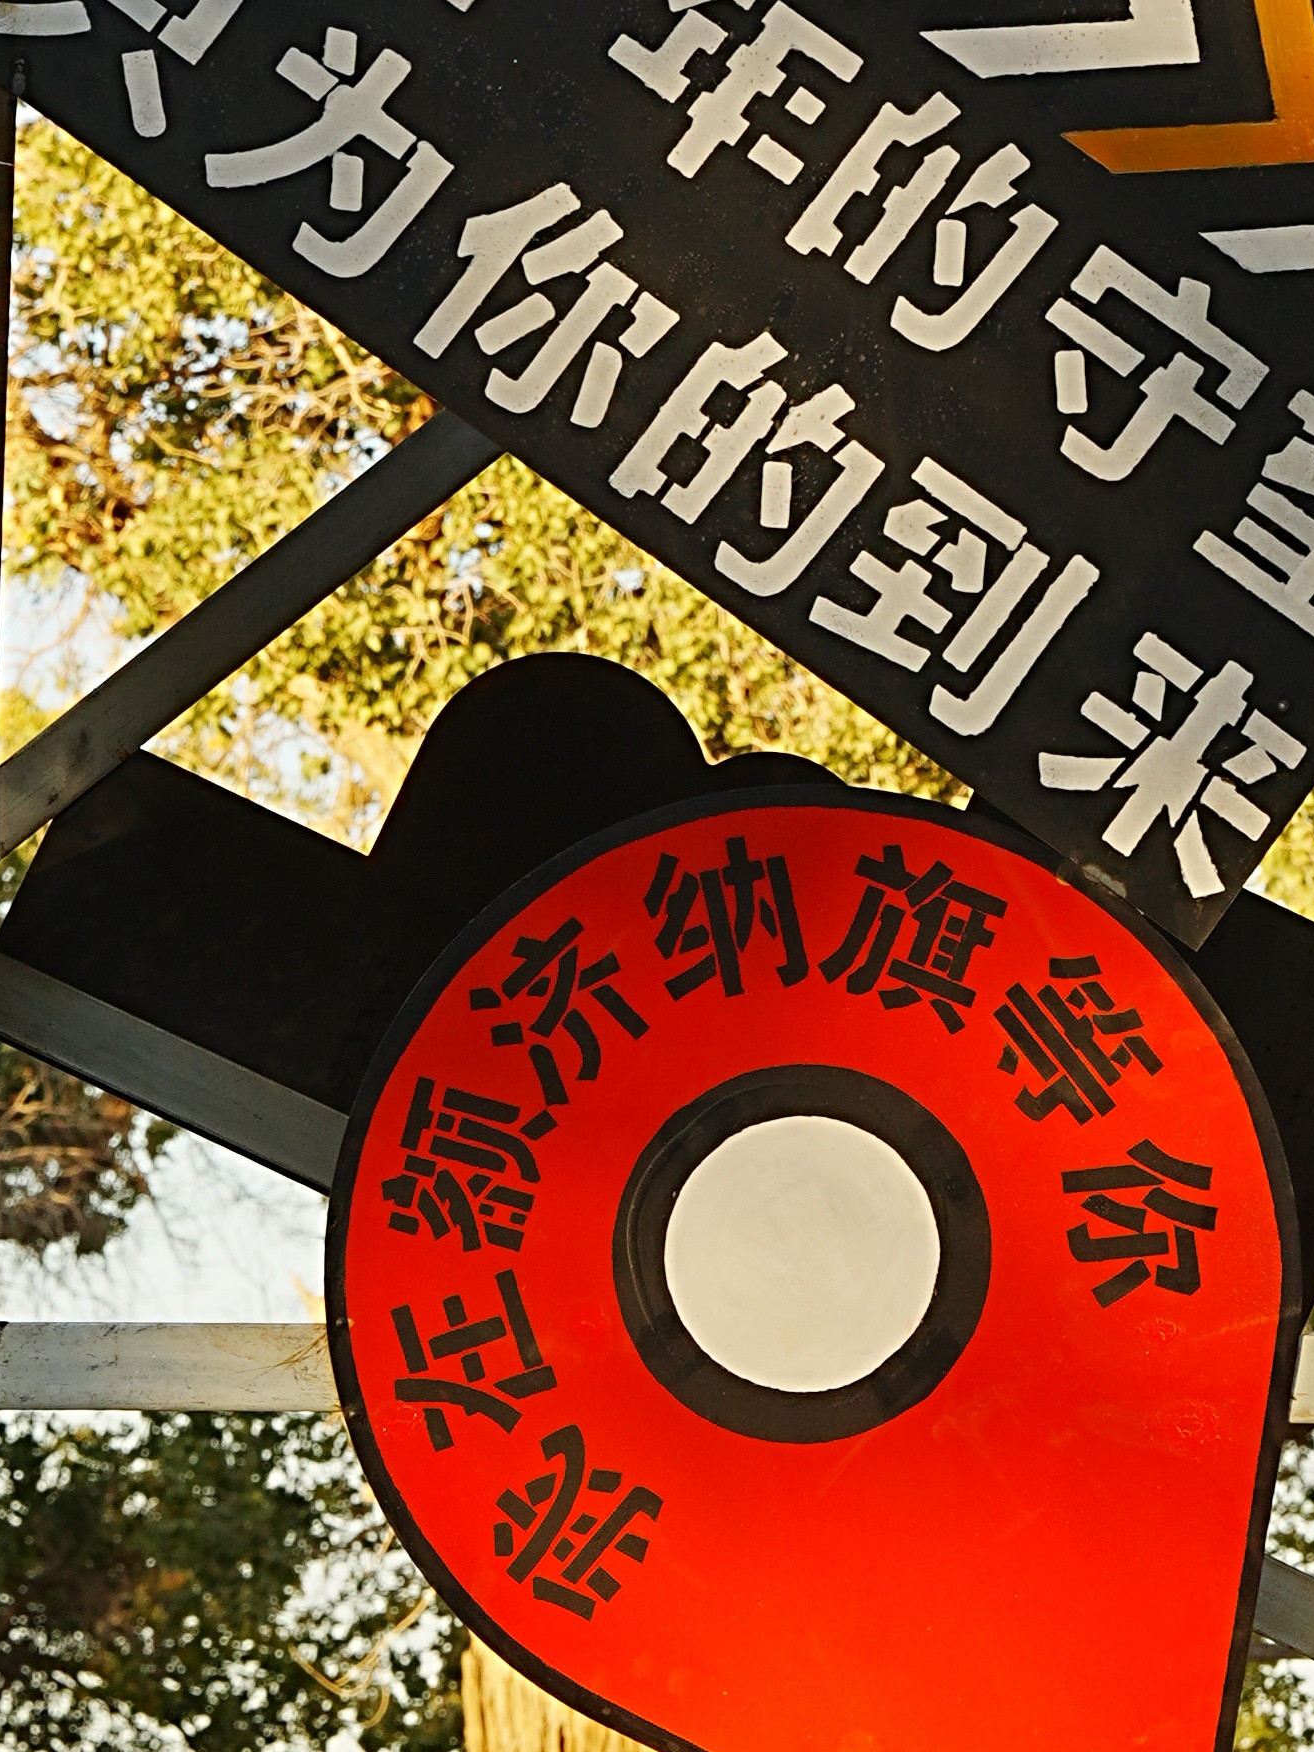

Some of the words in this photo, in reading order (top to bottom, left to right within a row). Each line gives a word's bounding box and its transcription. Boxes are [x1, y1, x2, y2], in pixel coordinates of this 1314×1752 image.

[380, 836, 1218, 1621] 我在额济纳旗等你
